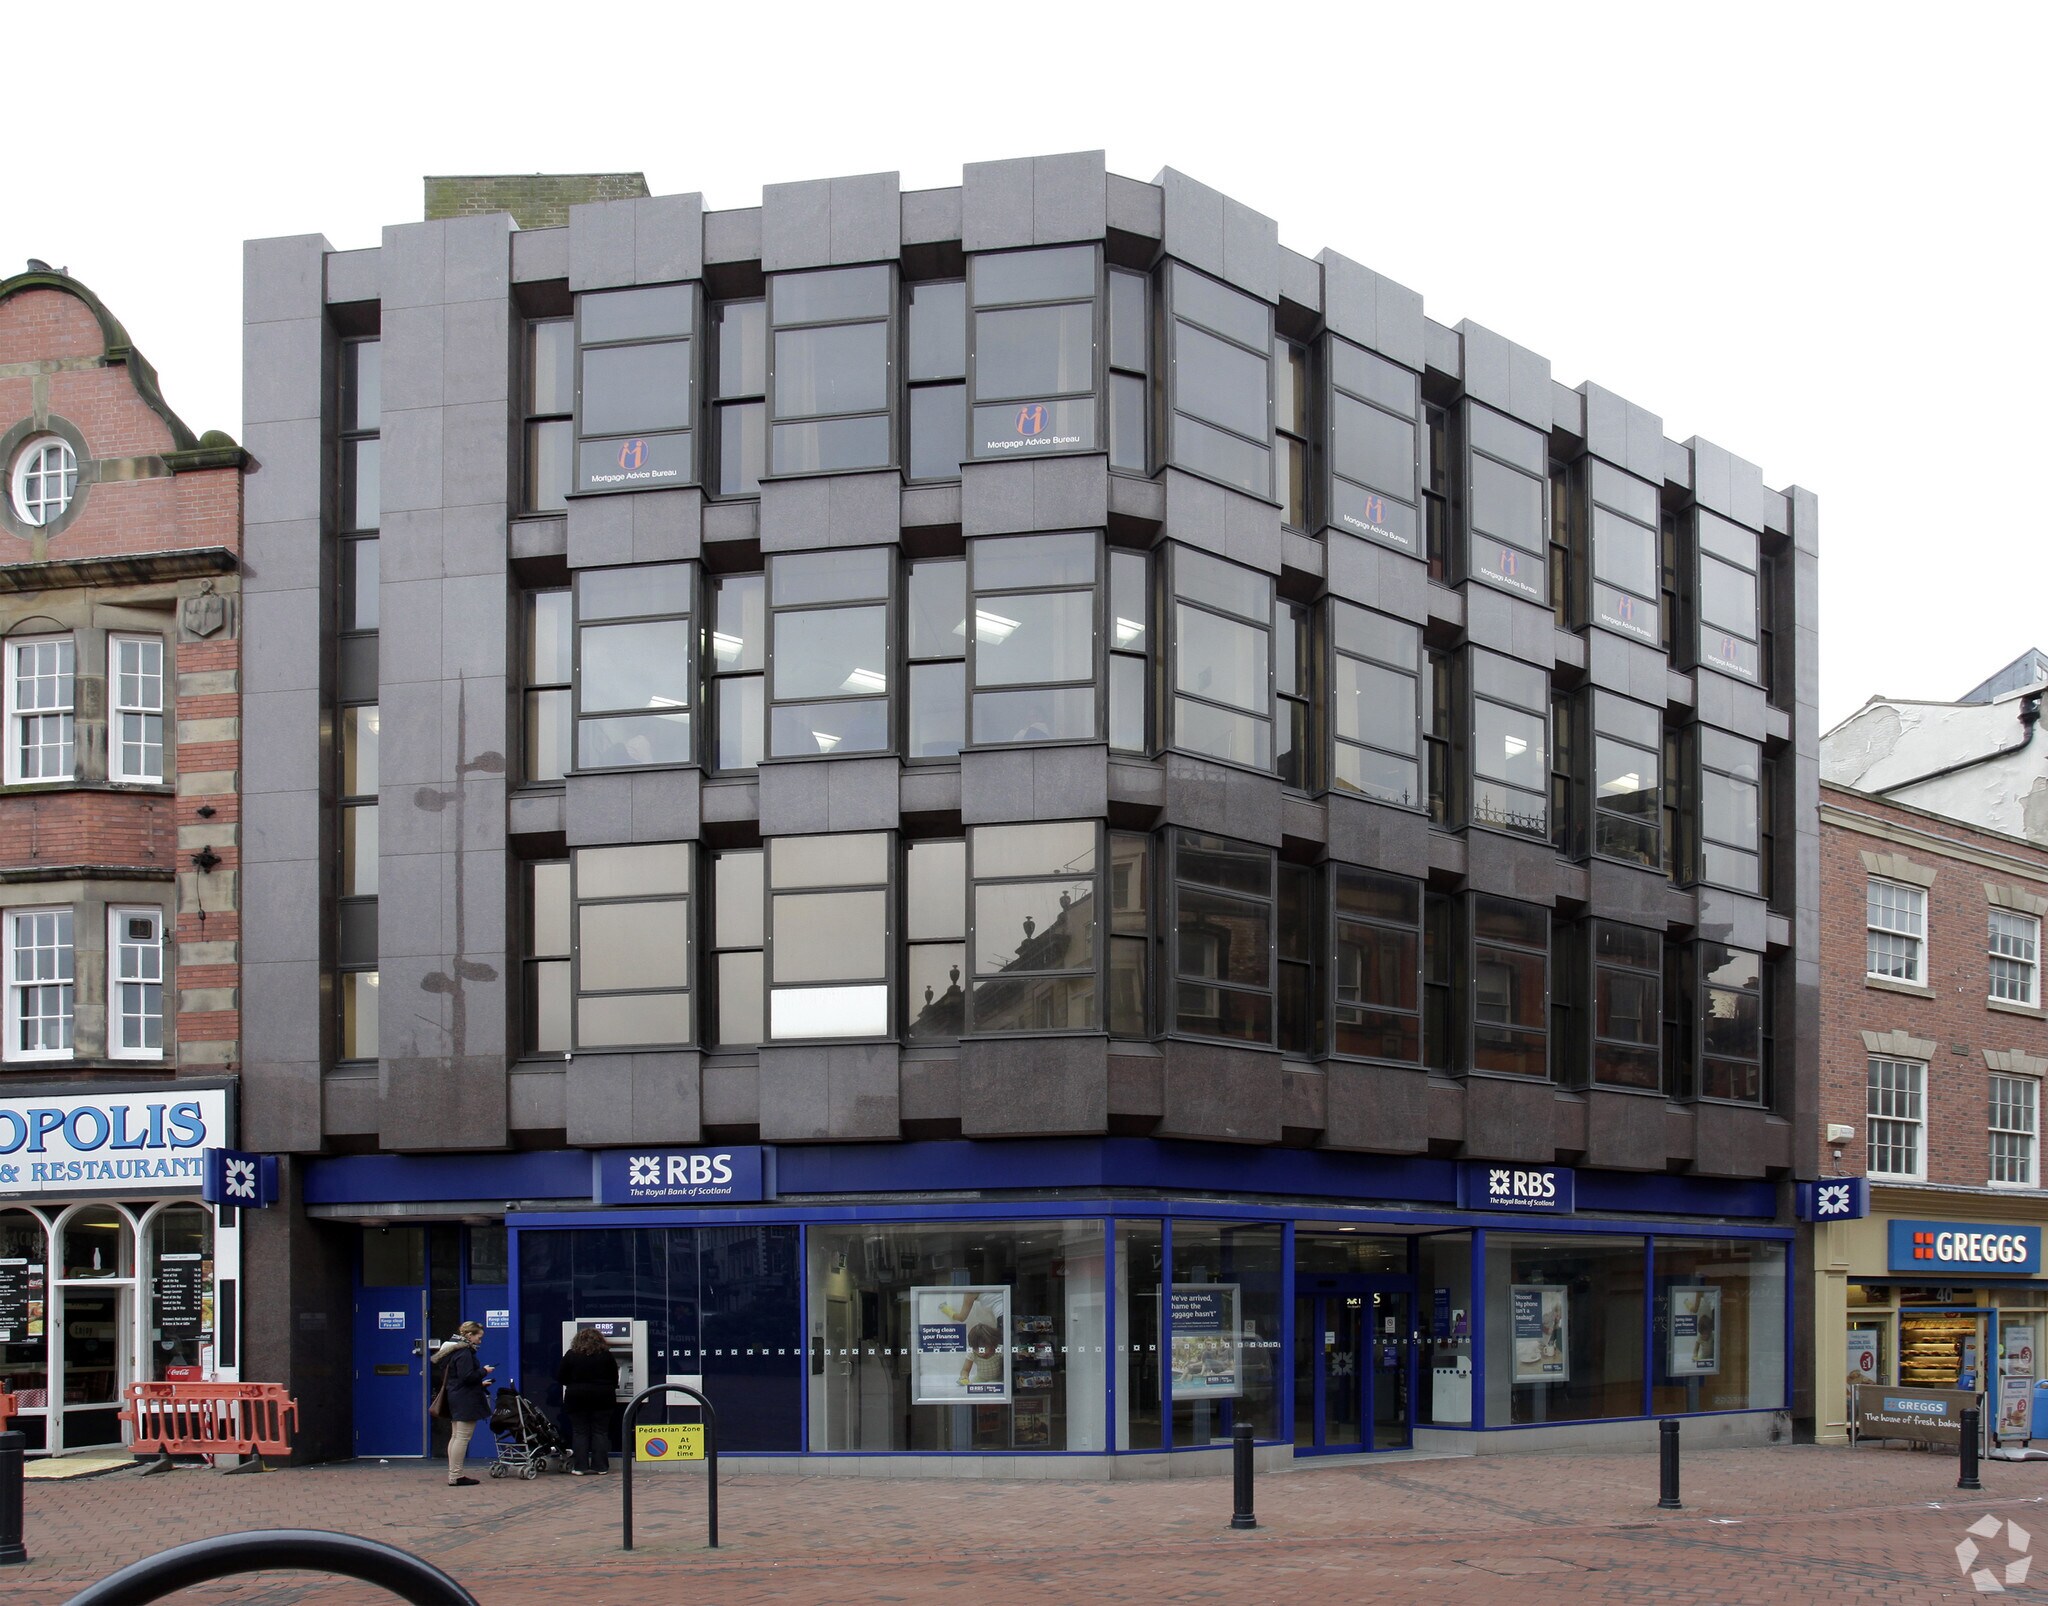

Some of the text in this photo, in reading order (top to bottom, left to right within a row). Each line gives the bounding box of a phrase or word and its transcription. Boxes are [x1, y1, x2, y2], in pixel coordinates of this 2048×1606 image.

[987, 436, 1080, 449] Mortgage Advice Bureau
[591, 469, 678, 482] Mortgage Advice Bureau
[0, 1101, 206, 1154] OPOLIS
[32, 1157, 203, 1181] RESTAURANT
[667, 1154, 733, 1185] RBS
[1514, 1171, 1556, 1198] RBS
[630, 1187, 732, 1198] The Royal Bank of Scotland
[1499, 1198, 1514, 1206] Royal
[1527, 1199, 1534, 1207] of
[1936, 1232, 2027, 1263] GREGGS
[1189, 1294, 1213, 1302] arrived,
[1936, 1288, 1952, 1303] 40
[1171, 1302, 1201, 1310] hame the
[1863, 1356, 1871, 1368] £1
[1898, 1401, 1943, 1412] GREGGS
[1864, 1412, 1879, 1421] The
[1881, 1414, 1900, 1423] home
[1902, 1415, 1912, 1424] of
[1914, 1416, 1936, 1426] fresh
